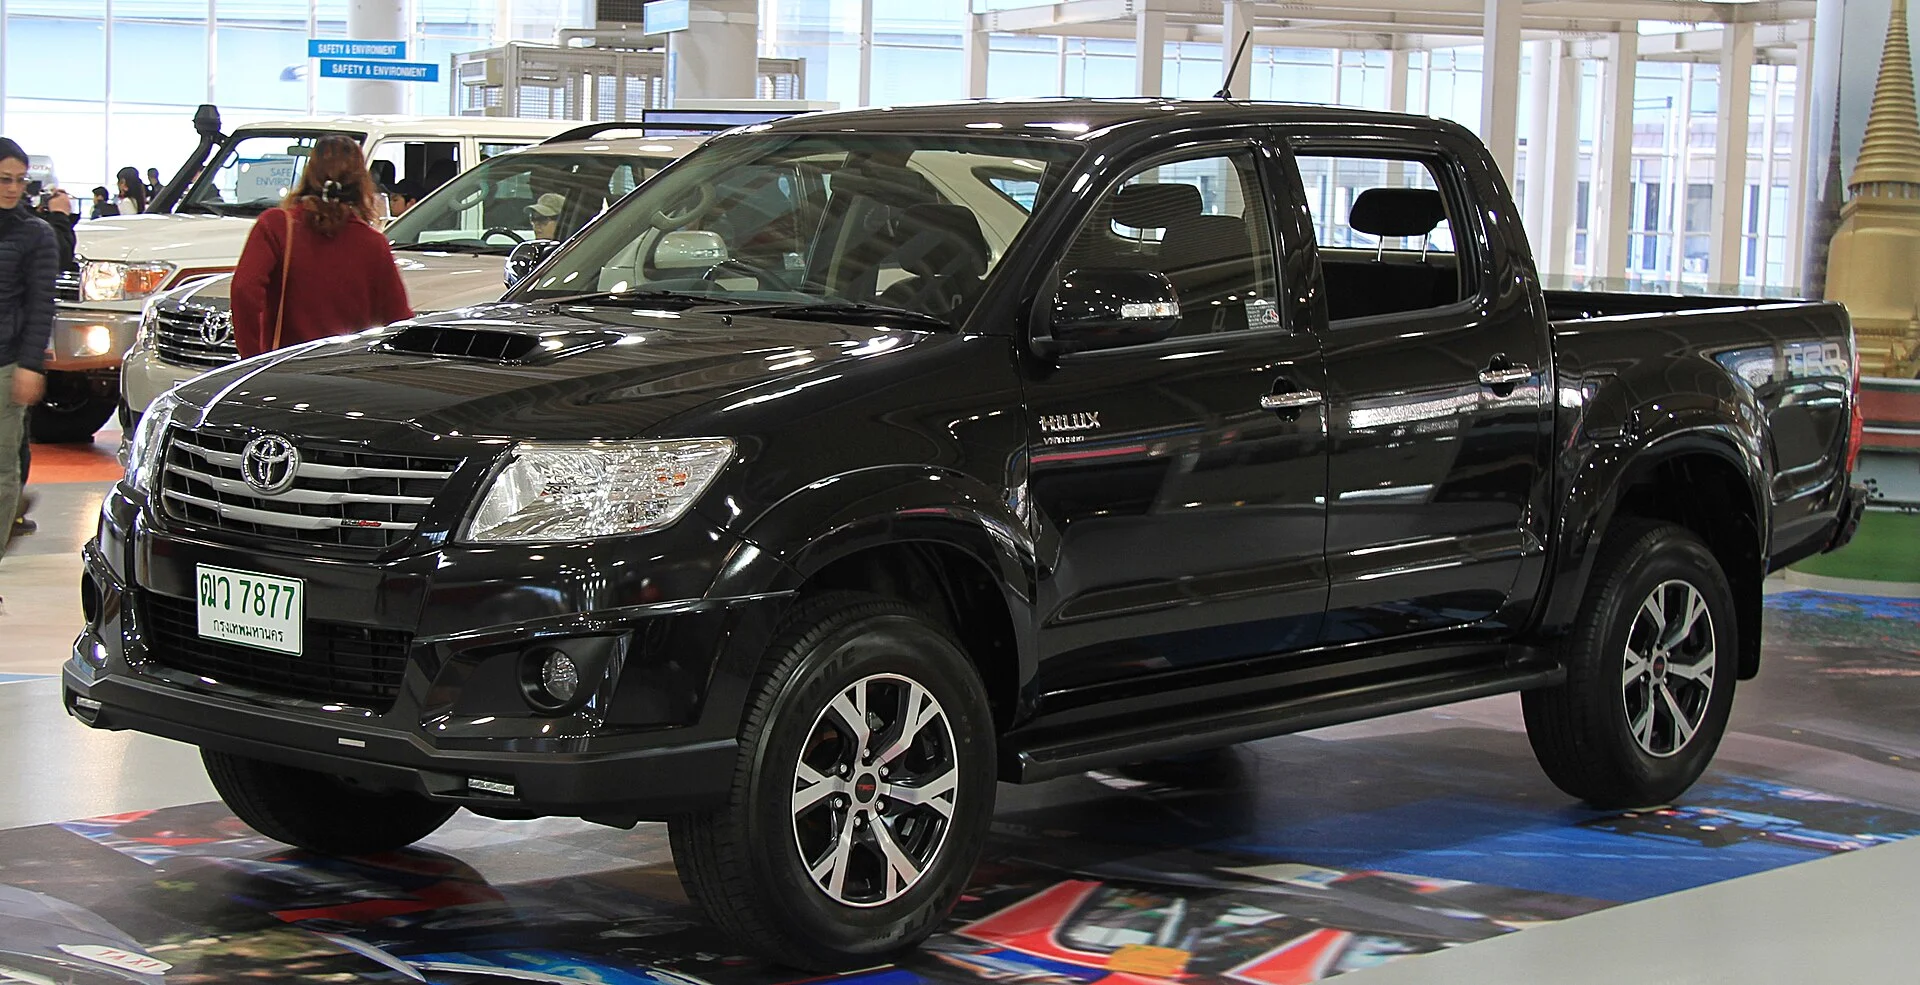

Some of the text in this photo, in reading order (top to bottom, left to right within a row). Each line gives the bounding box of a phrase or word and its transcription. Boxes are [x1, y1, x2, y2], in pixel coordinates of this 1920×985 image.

[318, 44, 398, 55] SAFETY & ENVIRONMENT
[332, 63, 428, 77] SAFETY & ENVIRONMENT
[271, 168, 292, 177] SAFE
[256, 177, 291, 186] ENVIRO
[1039, 411, 1101, 431] HILUX
[239, 579, 295, 620] 7877
[213, 619, 284, 643] กรุงเทพมหานคร
[96, 949, 161, 969] TAXI
